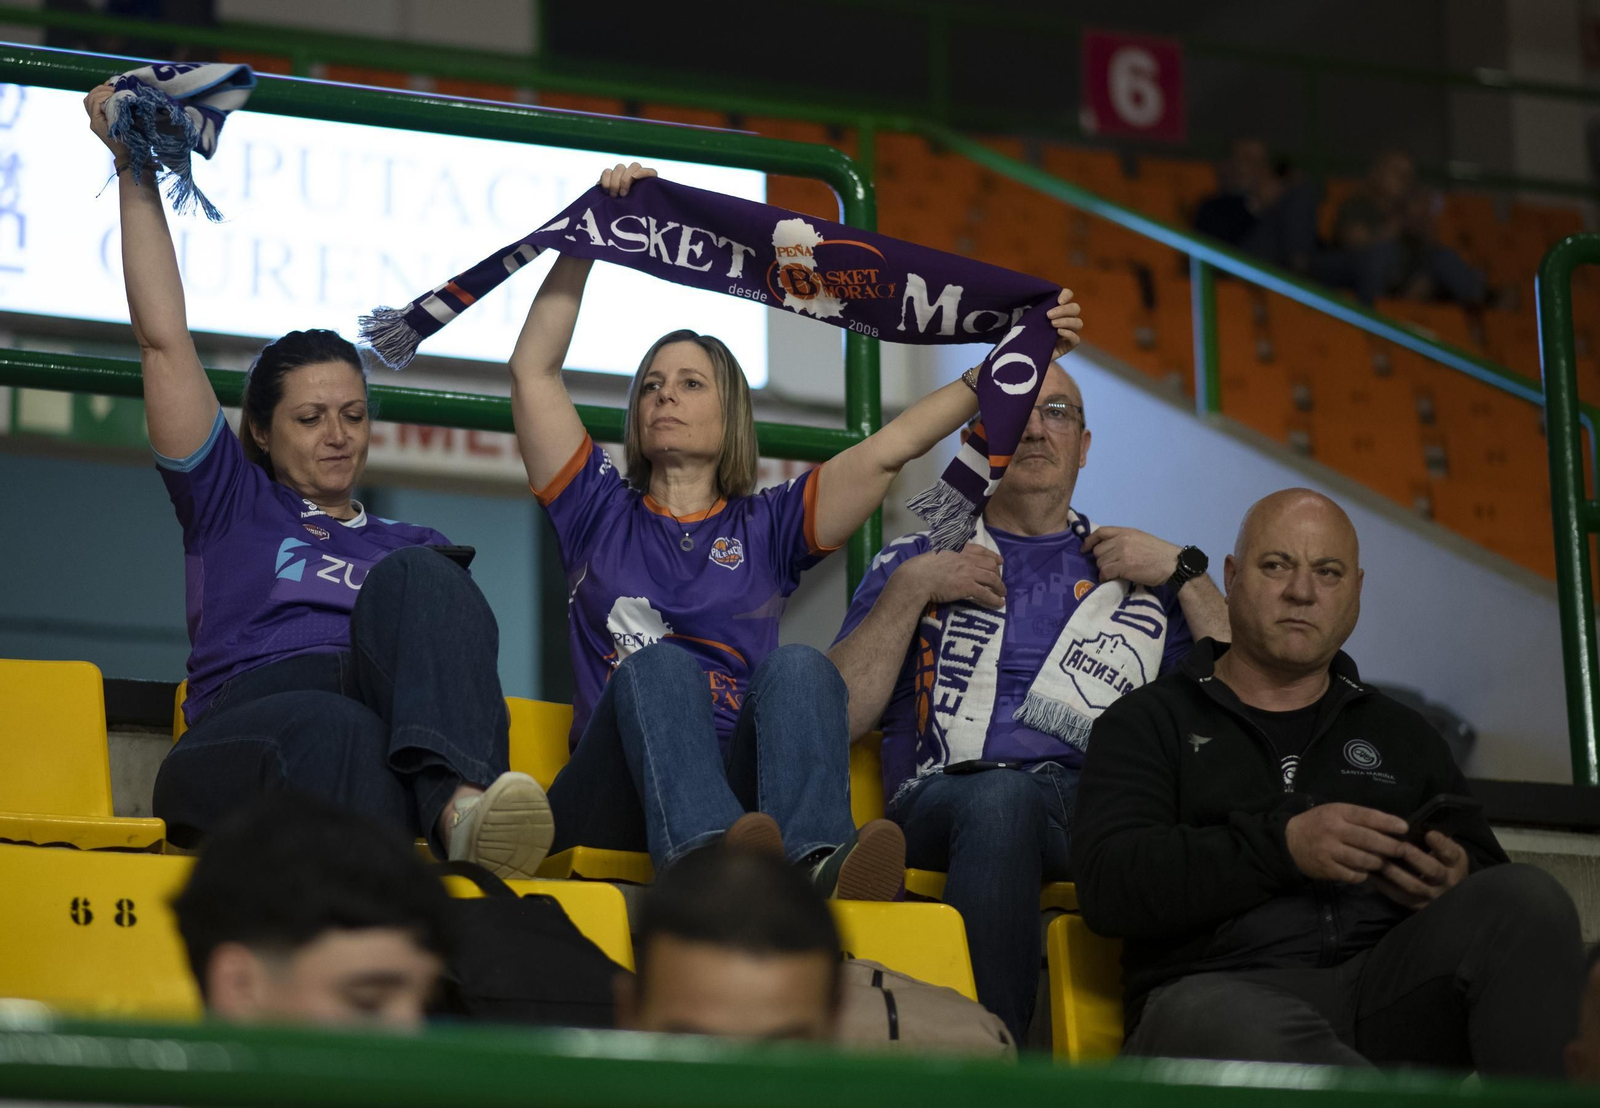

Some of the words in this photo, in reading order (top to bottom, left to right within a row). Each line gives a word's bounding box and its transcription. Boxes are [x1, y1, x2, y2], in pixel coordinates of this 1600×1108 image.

[1107, 47, 1164, 128] 6
[535, 207, 756, 279] ASKET
[777, 244, 813, 258] PEÑA
[728, 283, 768, 303] desde
[785, 268, 879, 296] BASKET
[848, 319, 880, 338] 2008
